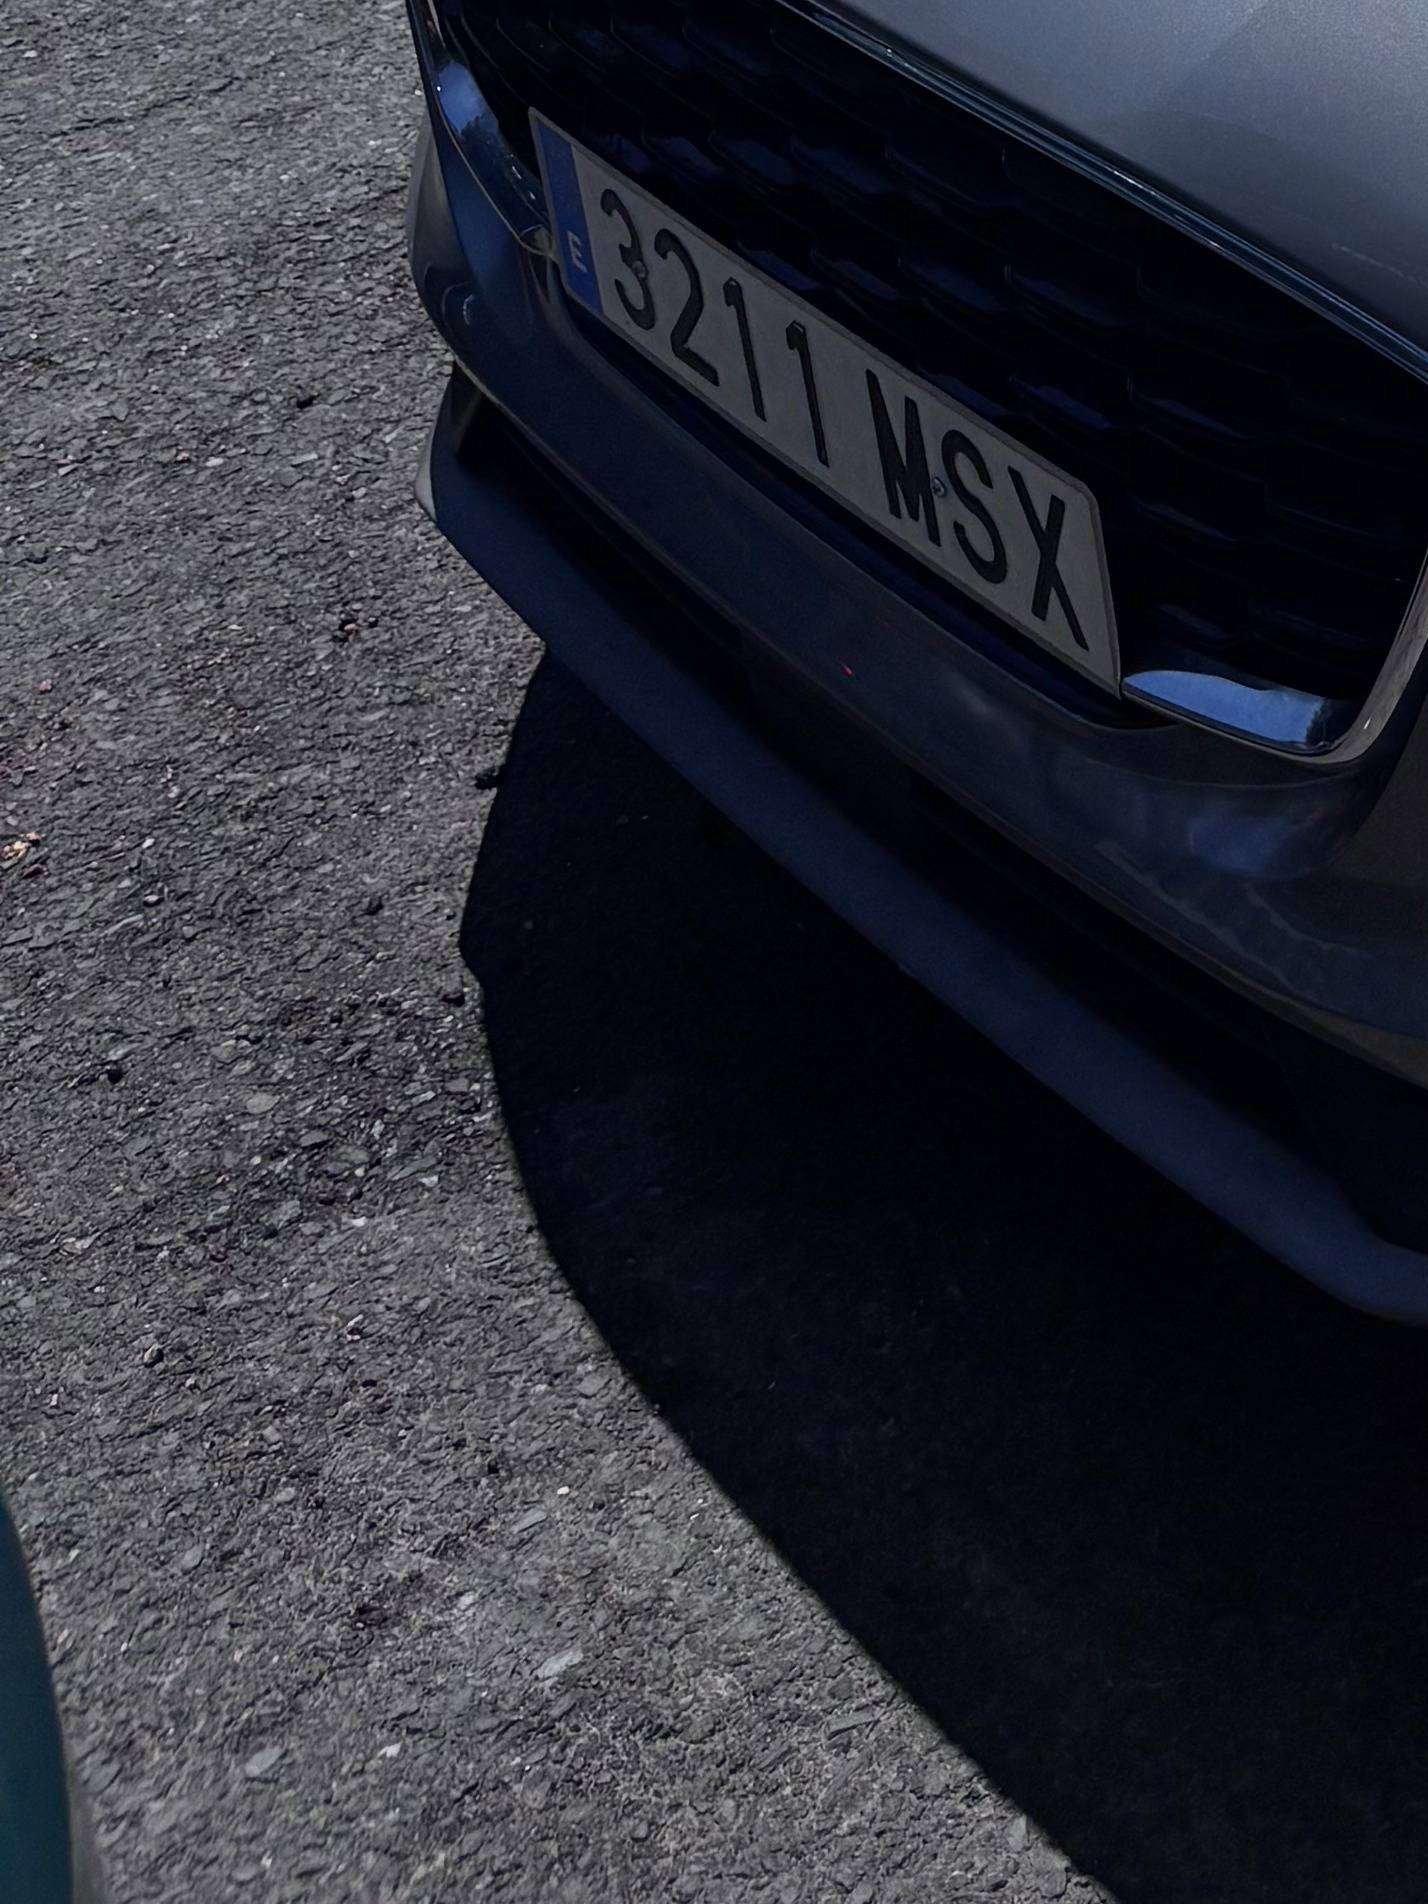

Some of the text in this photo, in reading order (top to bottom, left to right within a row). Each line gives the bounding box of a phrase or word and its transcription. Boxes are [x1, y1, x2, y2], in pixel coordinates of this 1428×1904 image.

[566, 230, 588, 273] E
[600, 188, 1091, 653] 3211 MSX
